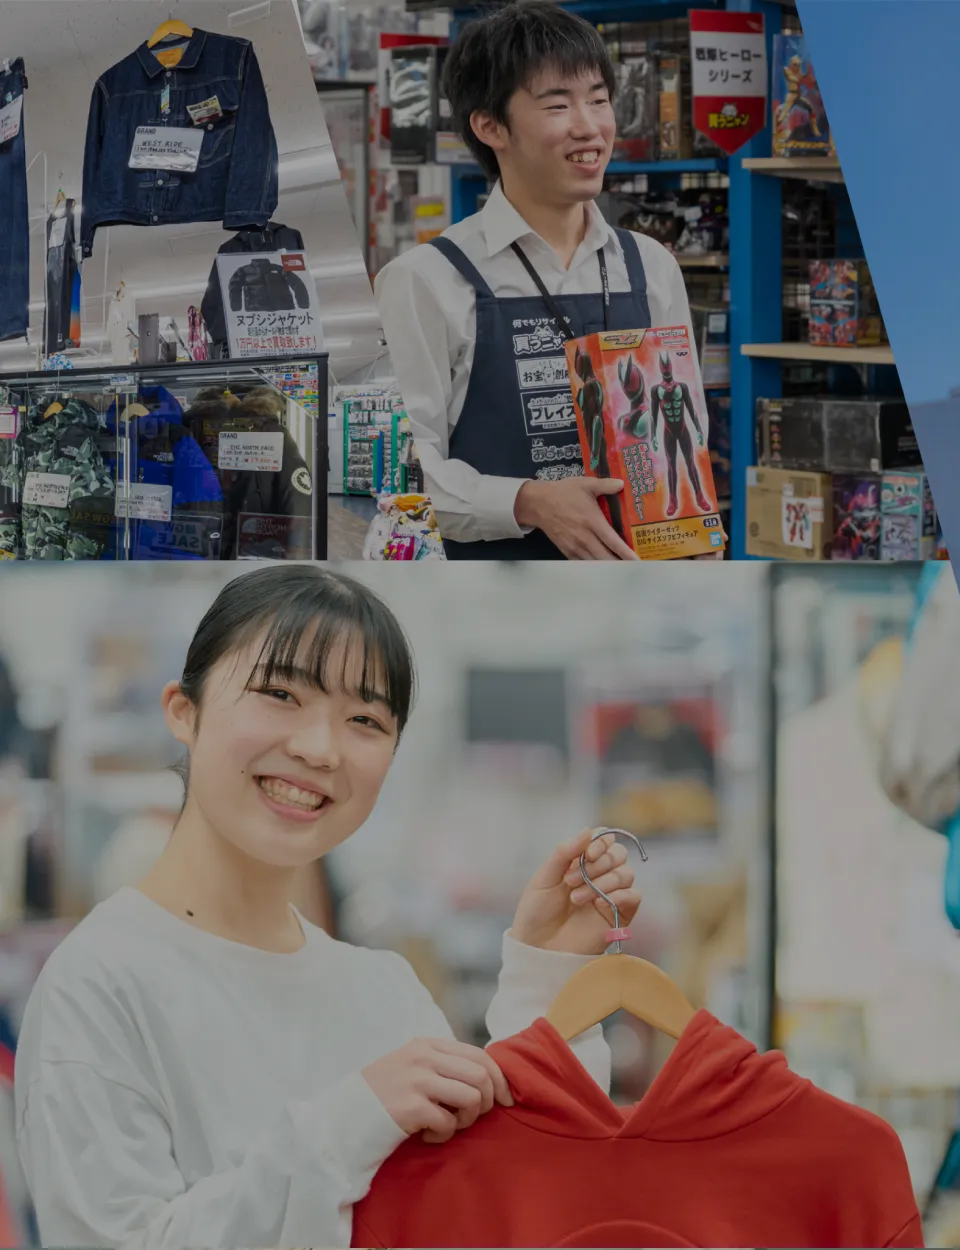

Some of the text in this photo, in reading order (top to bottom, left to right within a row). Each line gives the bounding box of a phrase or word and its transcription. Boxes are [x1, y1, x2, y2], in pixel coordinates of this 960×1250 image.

[709, 69, 752, 82] シリーズ
[237, 312, 314, 326] ヌプシジャケット
[513, 316, 571, 328] 何でもリサイル
